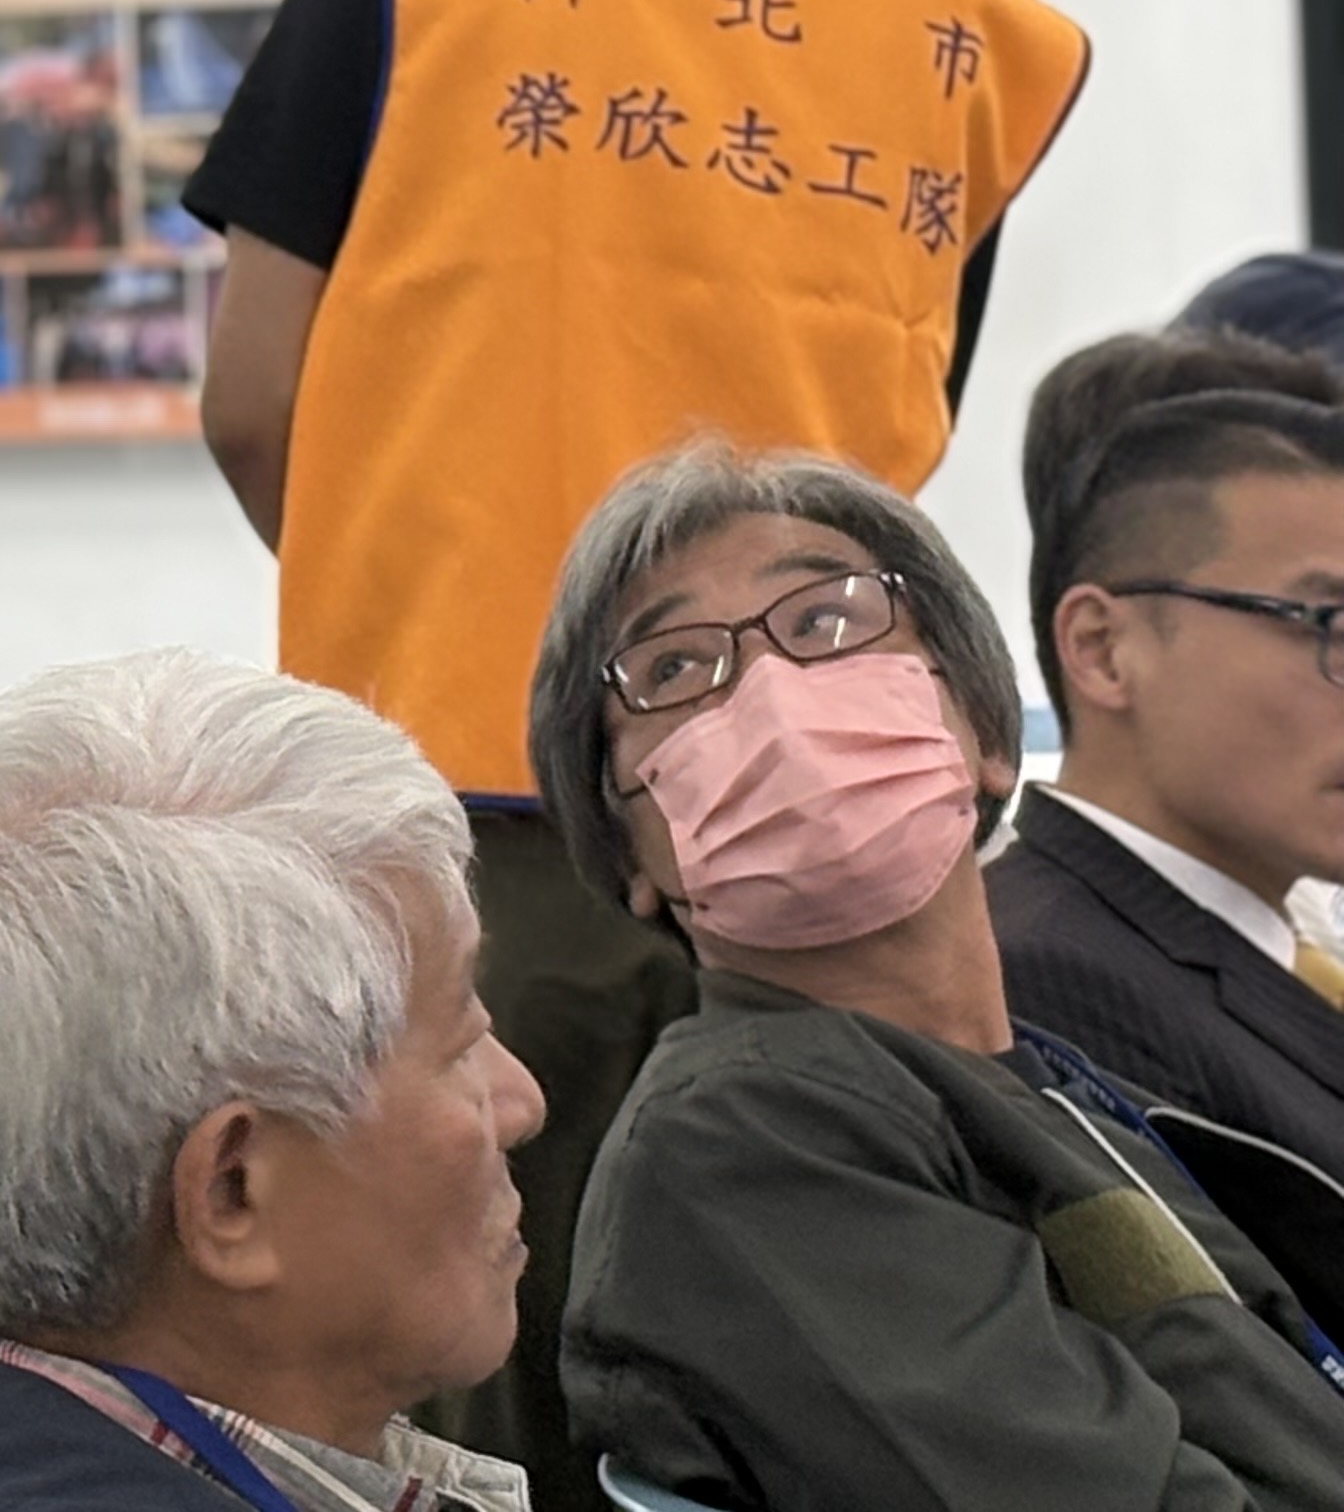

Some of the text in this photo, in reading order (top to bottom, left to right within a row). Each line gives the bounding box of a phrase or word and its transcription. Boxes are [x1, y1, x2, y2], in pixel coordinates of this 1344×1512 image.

[496, 71, 965, 256] 榮欣志工隊
